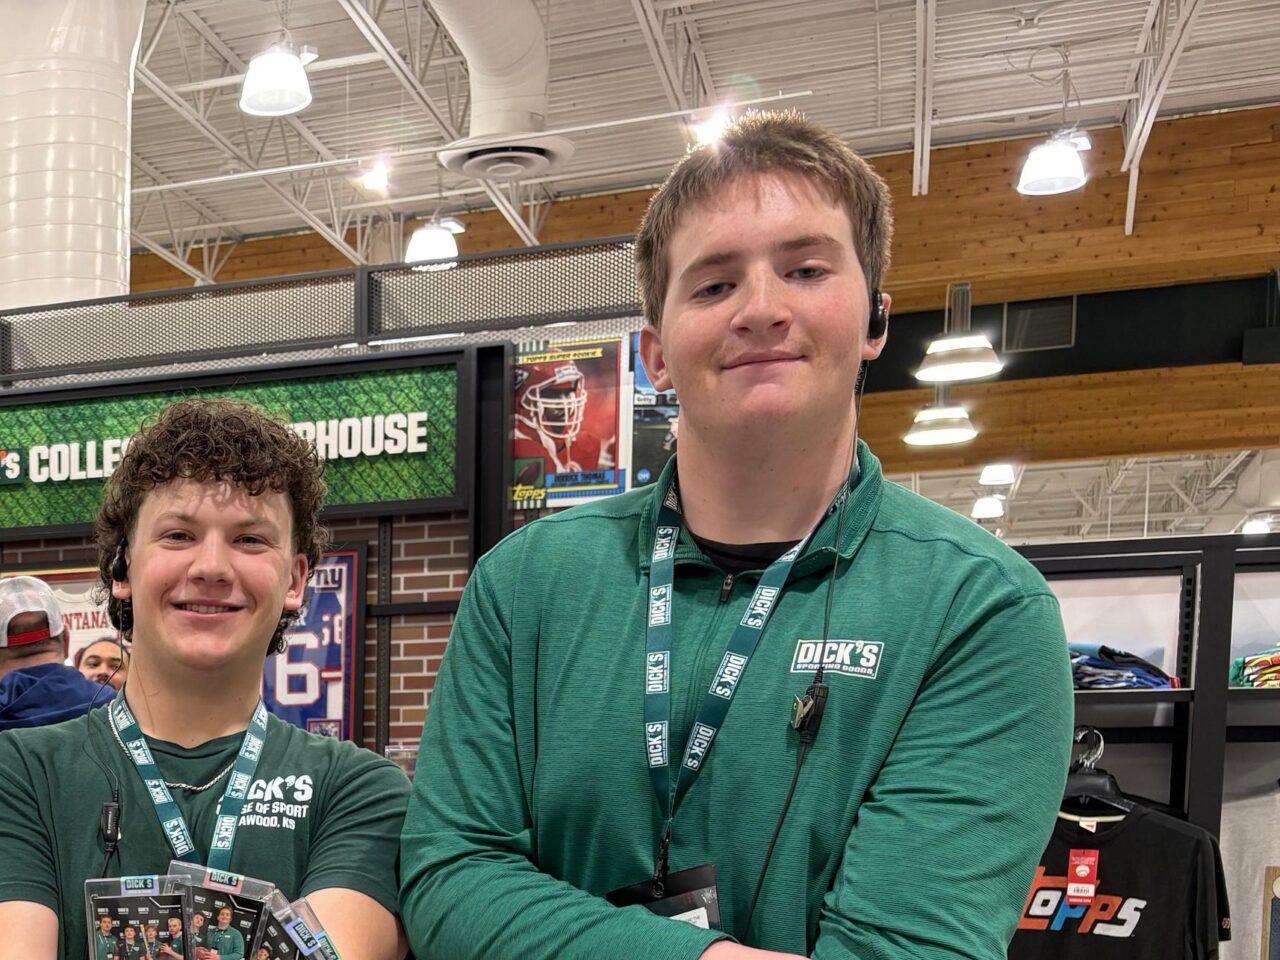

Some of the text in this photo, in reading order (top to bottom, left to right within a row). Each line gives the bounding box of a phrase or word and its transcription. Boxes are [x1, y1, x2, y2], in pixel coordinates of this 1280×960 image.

[29, 439, 128, 483] COLLE
[287, 412, 428, 459] HOUSE
[62, 611, 109, 630] NTANA
[797, 640, 879, 667] DICK'S
[261, 633, 319, 706] 6
[220, 775, 313, 802] CK'S
[255, 803, 270, 814] OF
[271, 802, 309, 819] SPORT
[238, 816, 296, 831] AWOOD, KS
[125, 878, 153, 890] DICK'S
[210, 871, 238, 886] DICK'S
[294, 923, 317, 948] DICK'S
